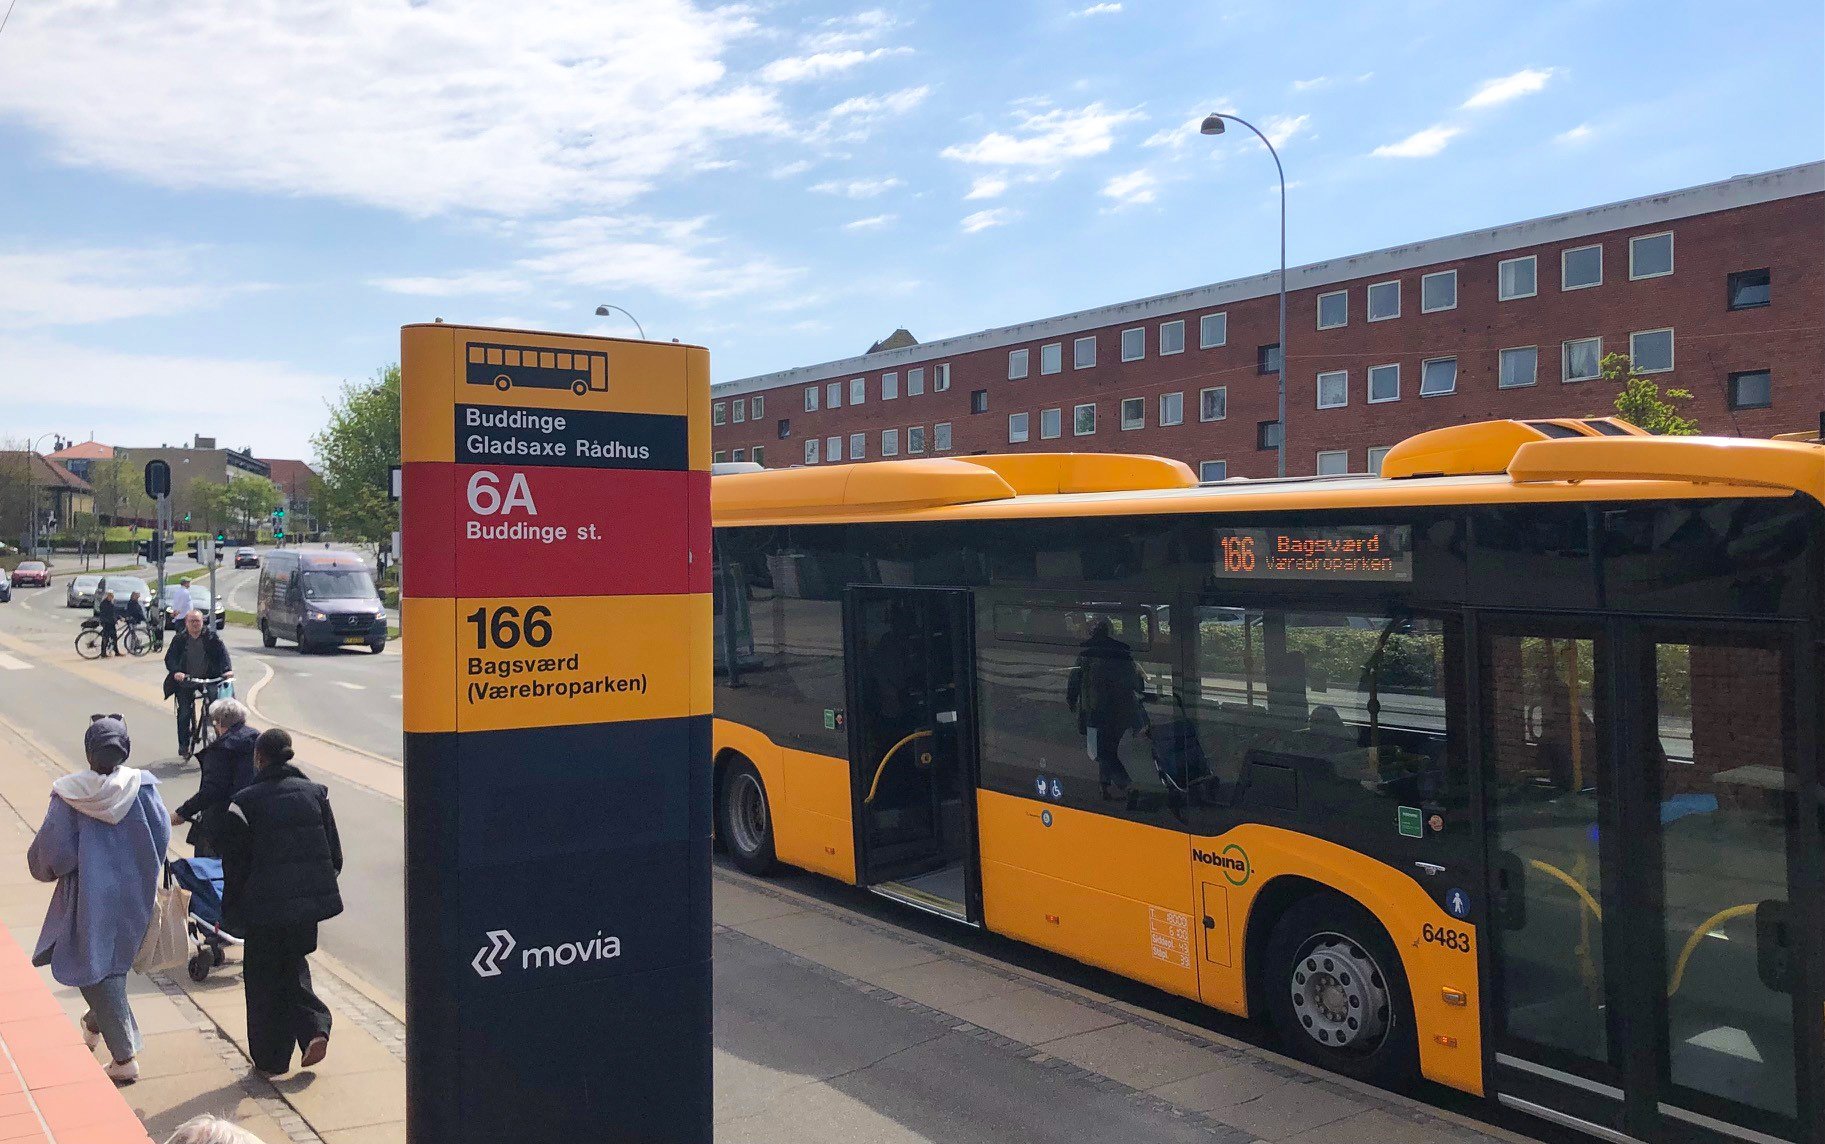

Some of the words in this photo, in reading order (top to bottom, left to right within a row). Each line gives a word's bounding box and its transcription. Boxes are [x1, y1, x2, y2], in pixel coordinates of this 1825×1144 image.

[466, 408, 566, 433] Buddinge
[466, 435, 566, 456] Gladsaxe
[576, 439, 650, 459] Rådhus
[466, 470, 537, 516] 6A
[466, 521, 567, 543] Buddinge
[577, 523, 602, 540] st.
[1221, 536, 1255, 572] 166
[1277, 534, 1379, 556] Bagsværd
[467, 605, 553, 650] 166
[468, 653, 579, 678] Bagsværd
[467, 674, 647, 704] (Værebroparken)
[1192, 848, 1245, 871] Nobina
[522, 930, 621, 970] movia
[1422, 922, 1470, 953] 6483
